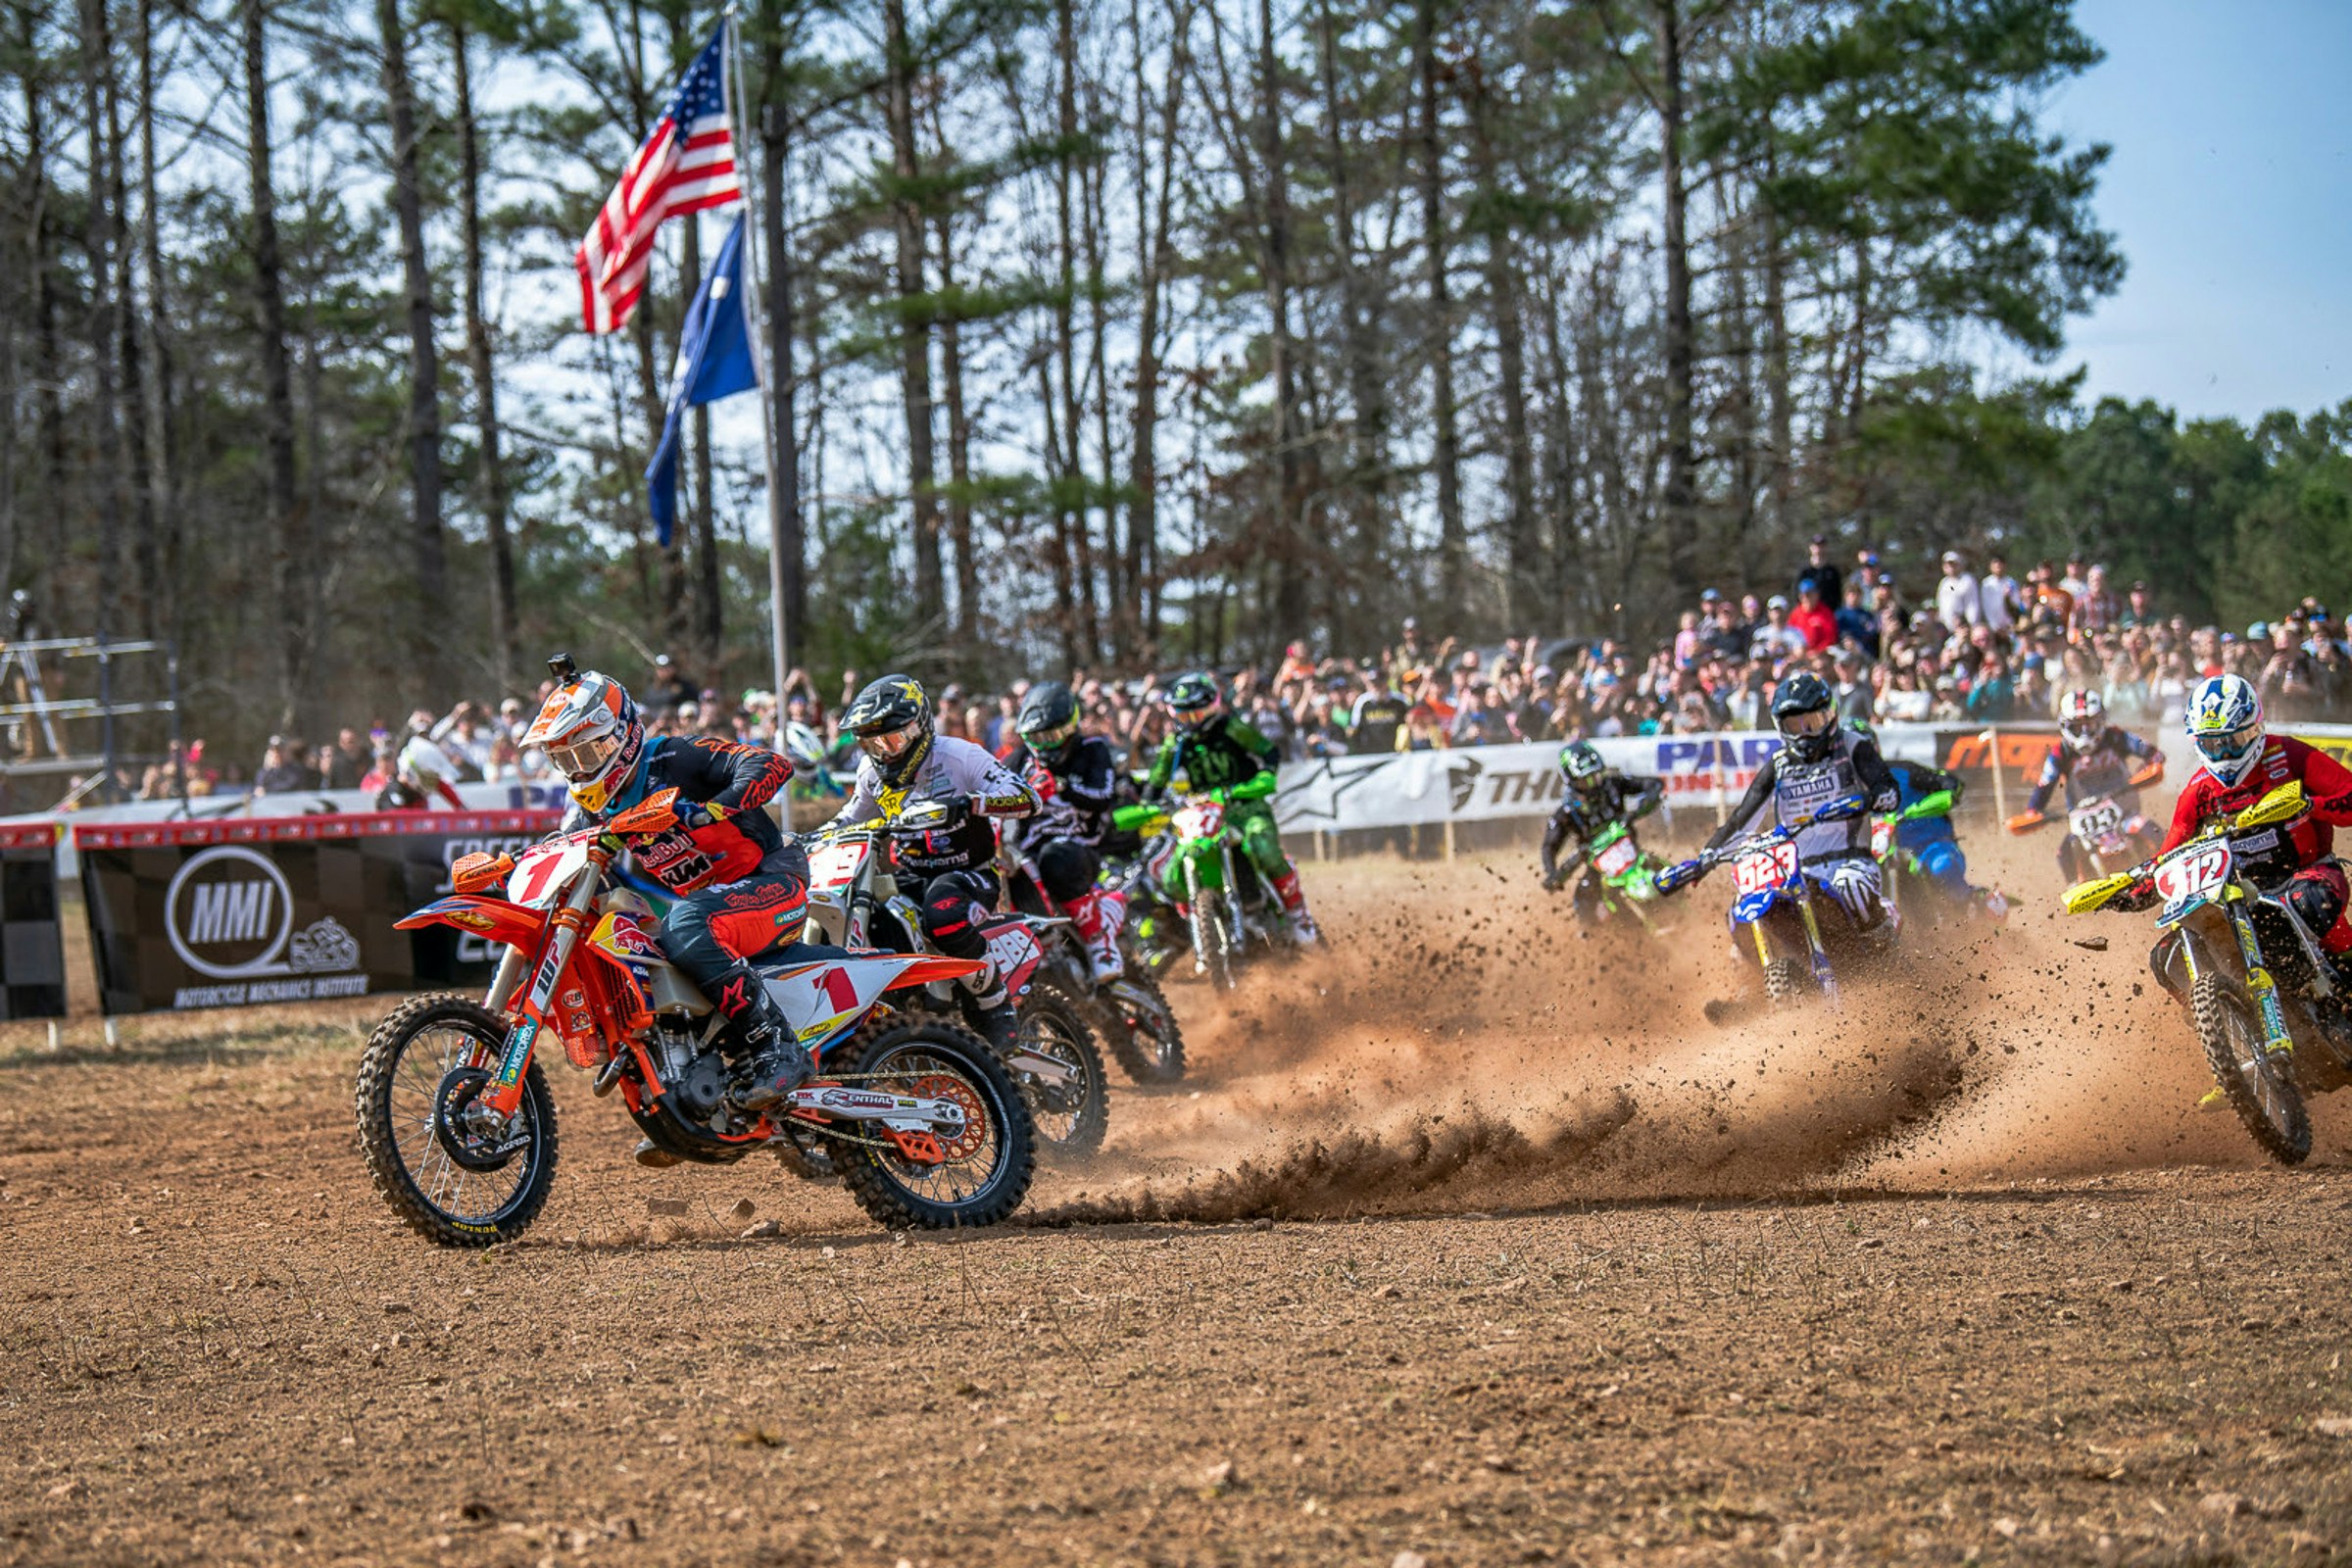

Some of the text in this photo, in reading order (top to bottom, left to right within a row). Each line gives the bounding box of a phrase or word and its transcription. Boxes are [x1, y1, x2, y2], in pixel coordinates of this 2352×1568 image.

[1789, 778, 1833, 798] YAMAHA
[527, 852, 565, 904] 1
[659, 854, 713, 887] KTM
[1738, 843, 1796, 894] 523
[188, 881, 273, 944] MMI
[173, 974, 369, 1008] MOTORCYCLE MECHANICS INSTITUTE
[811, 966, 860, 1014] 1
[509, 1024, 535, 1069] MOTOREX
